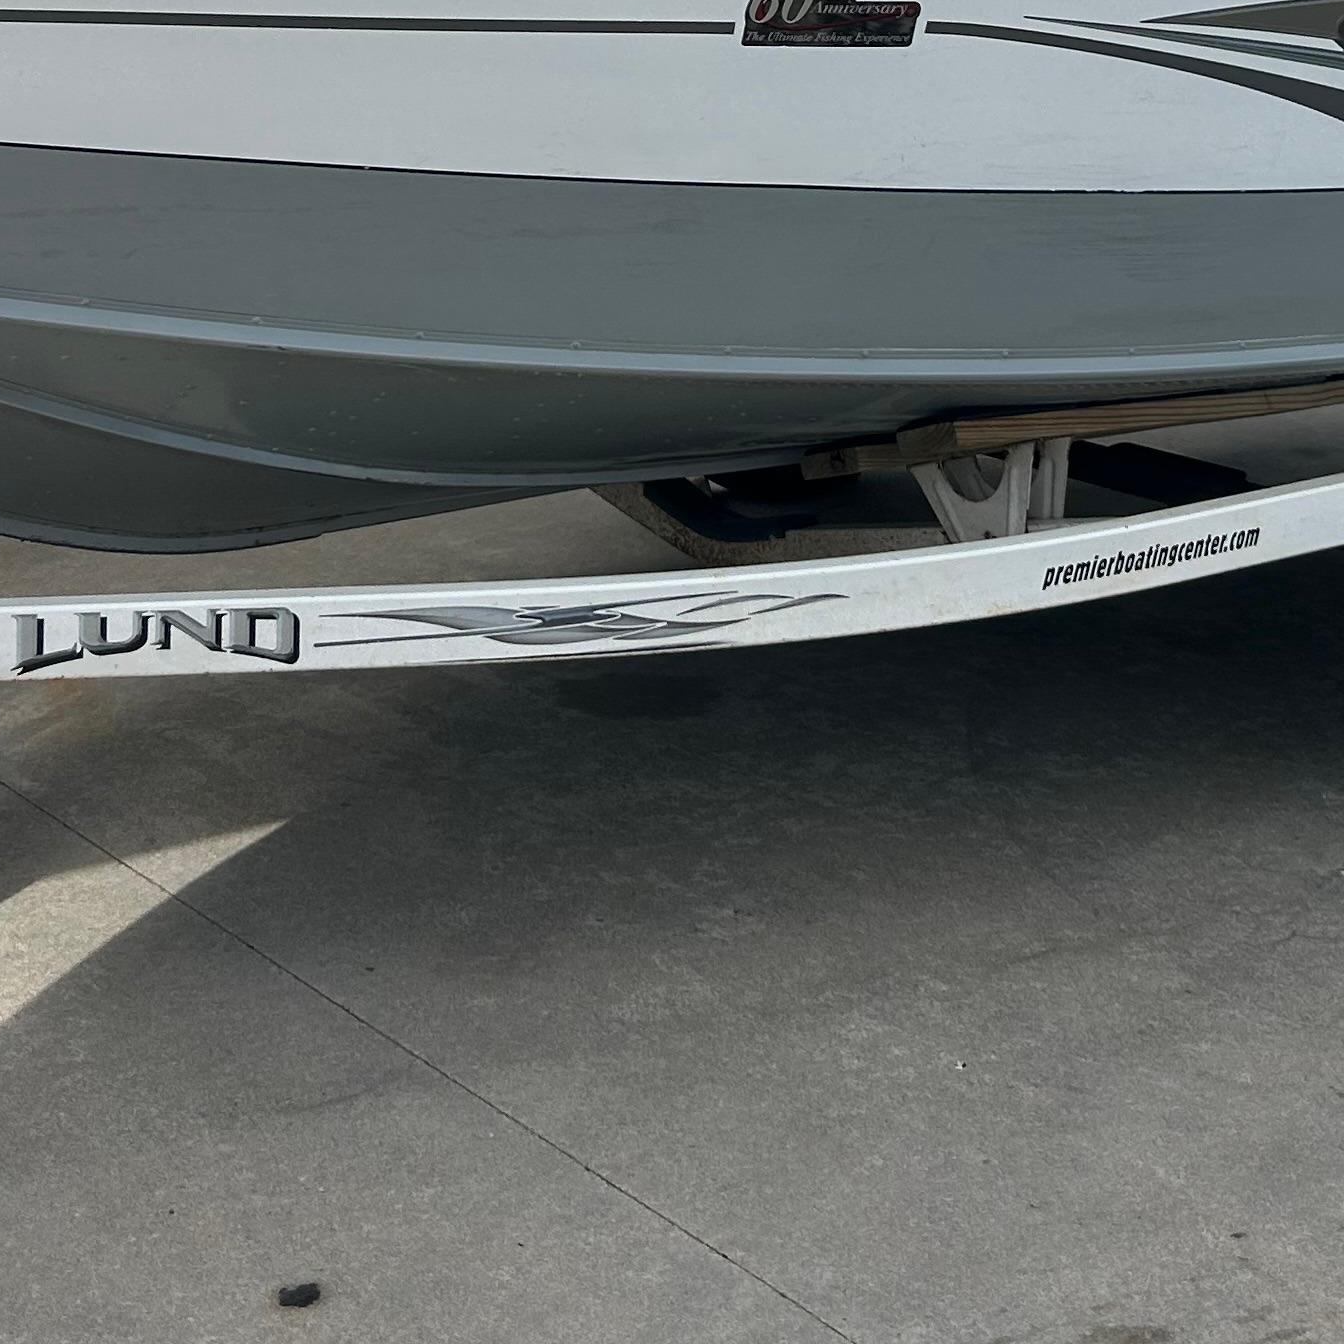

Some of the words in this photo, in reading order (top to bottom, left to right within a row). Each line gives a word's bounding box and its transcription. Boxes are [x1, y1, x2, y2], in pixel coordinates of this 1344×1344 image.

[810, 1, 912, 19] Anniversary
[745, 31, 765, 42] The
[767, 30, 814, 43] Ultimate
[814, 31, 851, 45] Fishing
[854, 31, 911, 45] Experience
[1042, 527, 1261, 591] premierboatingcenter.com
[10, 607, 300, 676] LUND
